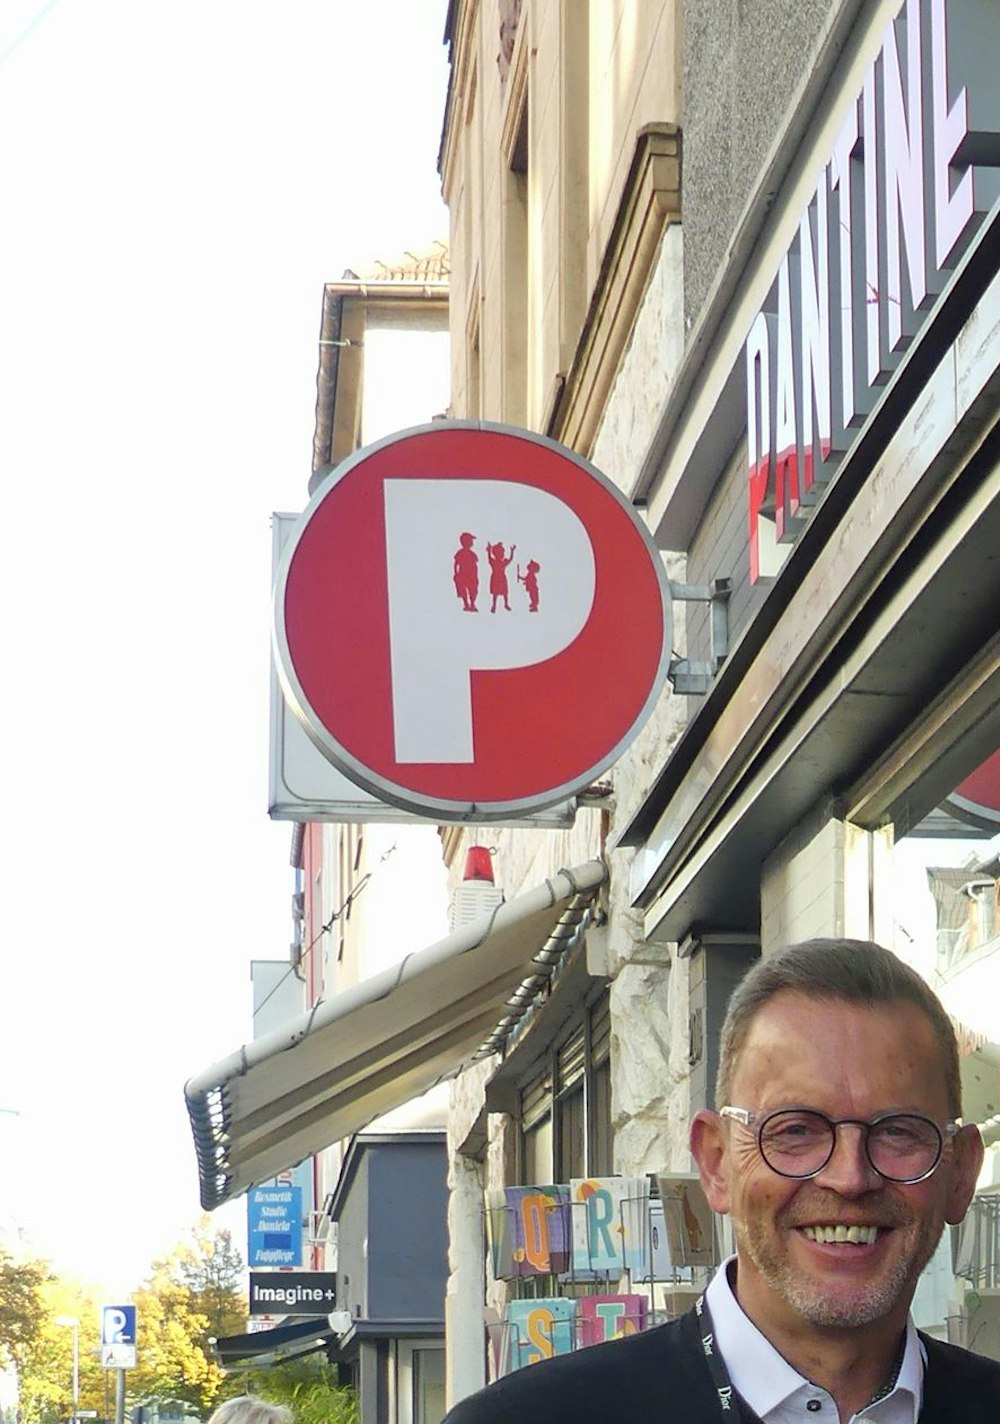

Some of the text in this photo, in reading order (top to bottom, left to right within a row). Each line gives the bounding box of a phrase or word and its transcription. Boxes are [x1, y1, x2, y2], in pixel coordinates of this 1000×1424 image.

[747, 0, 974, 586] PANTINE
[383, 477, 597, 765] P
[587, 1187, 617, 1259] R
[526, 1307, 557, 1364] S
[596, 1302, 627, 1342] T
[717, 1385, 731, 1411] Dior
